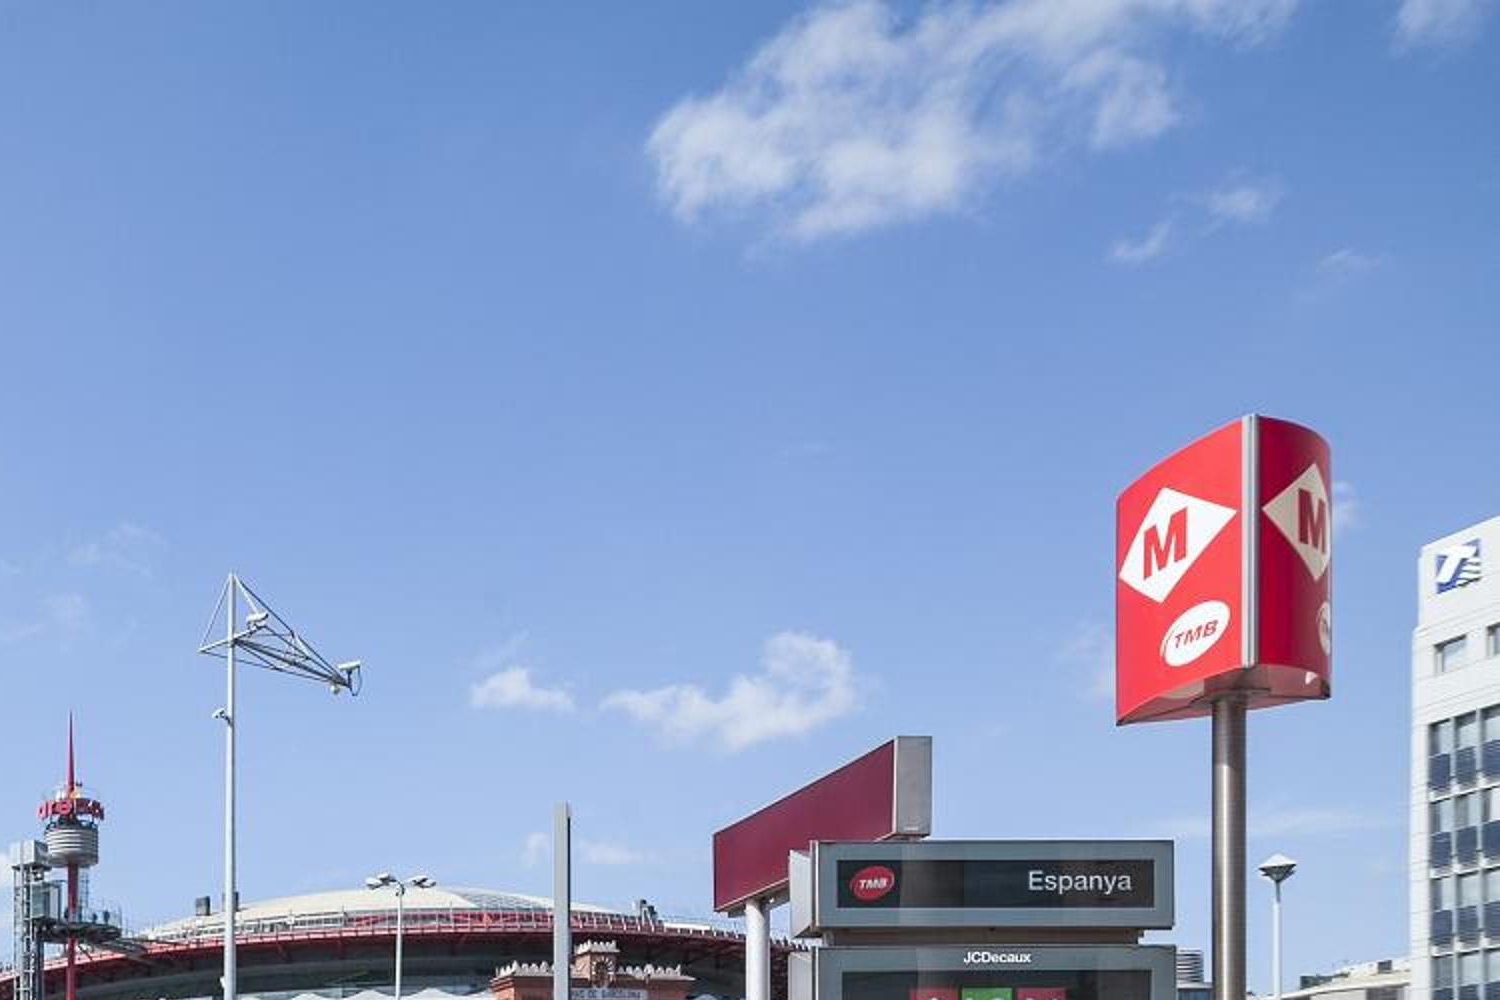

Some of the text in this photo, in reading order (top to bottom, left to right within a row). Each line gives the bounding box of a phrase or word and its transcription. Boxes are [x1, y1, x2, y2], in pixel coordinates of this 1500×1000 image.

[1143, 506, 1189, 581] M
[1174, 620, 1219, 649] TMB
[858, 878, 888, 889] TMB
[1028, 869, 1132, 894] Espanya
[963, 951, 1032, 965] JCDecaux
